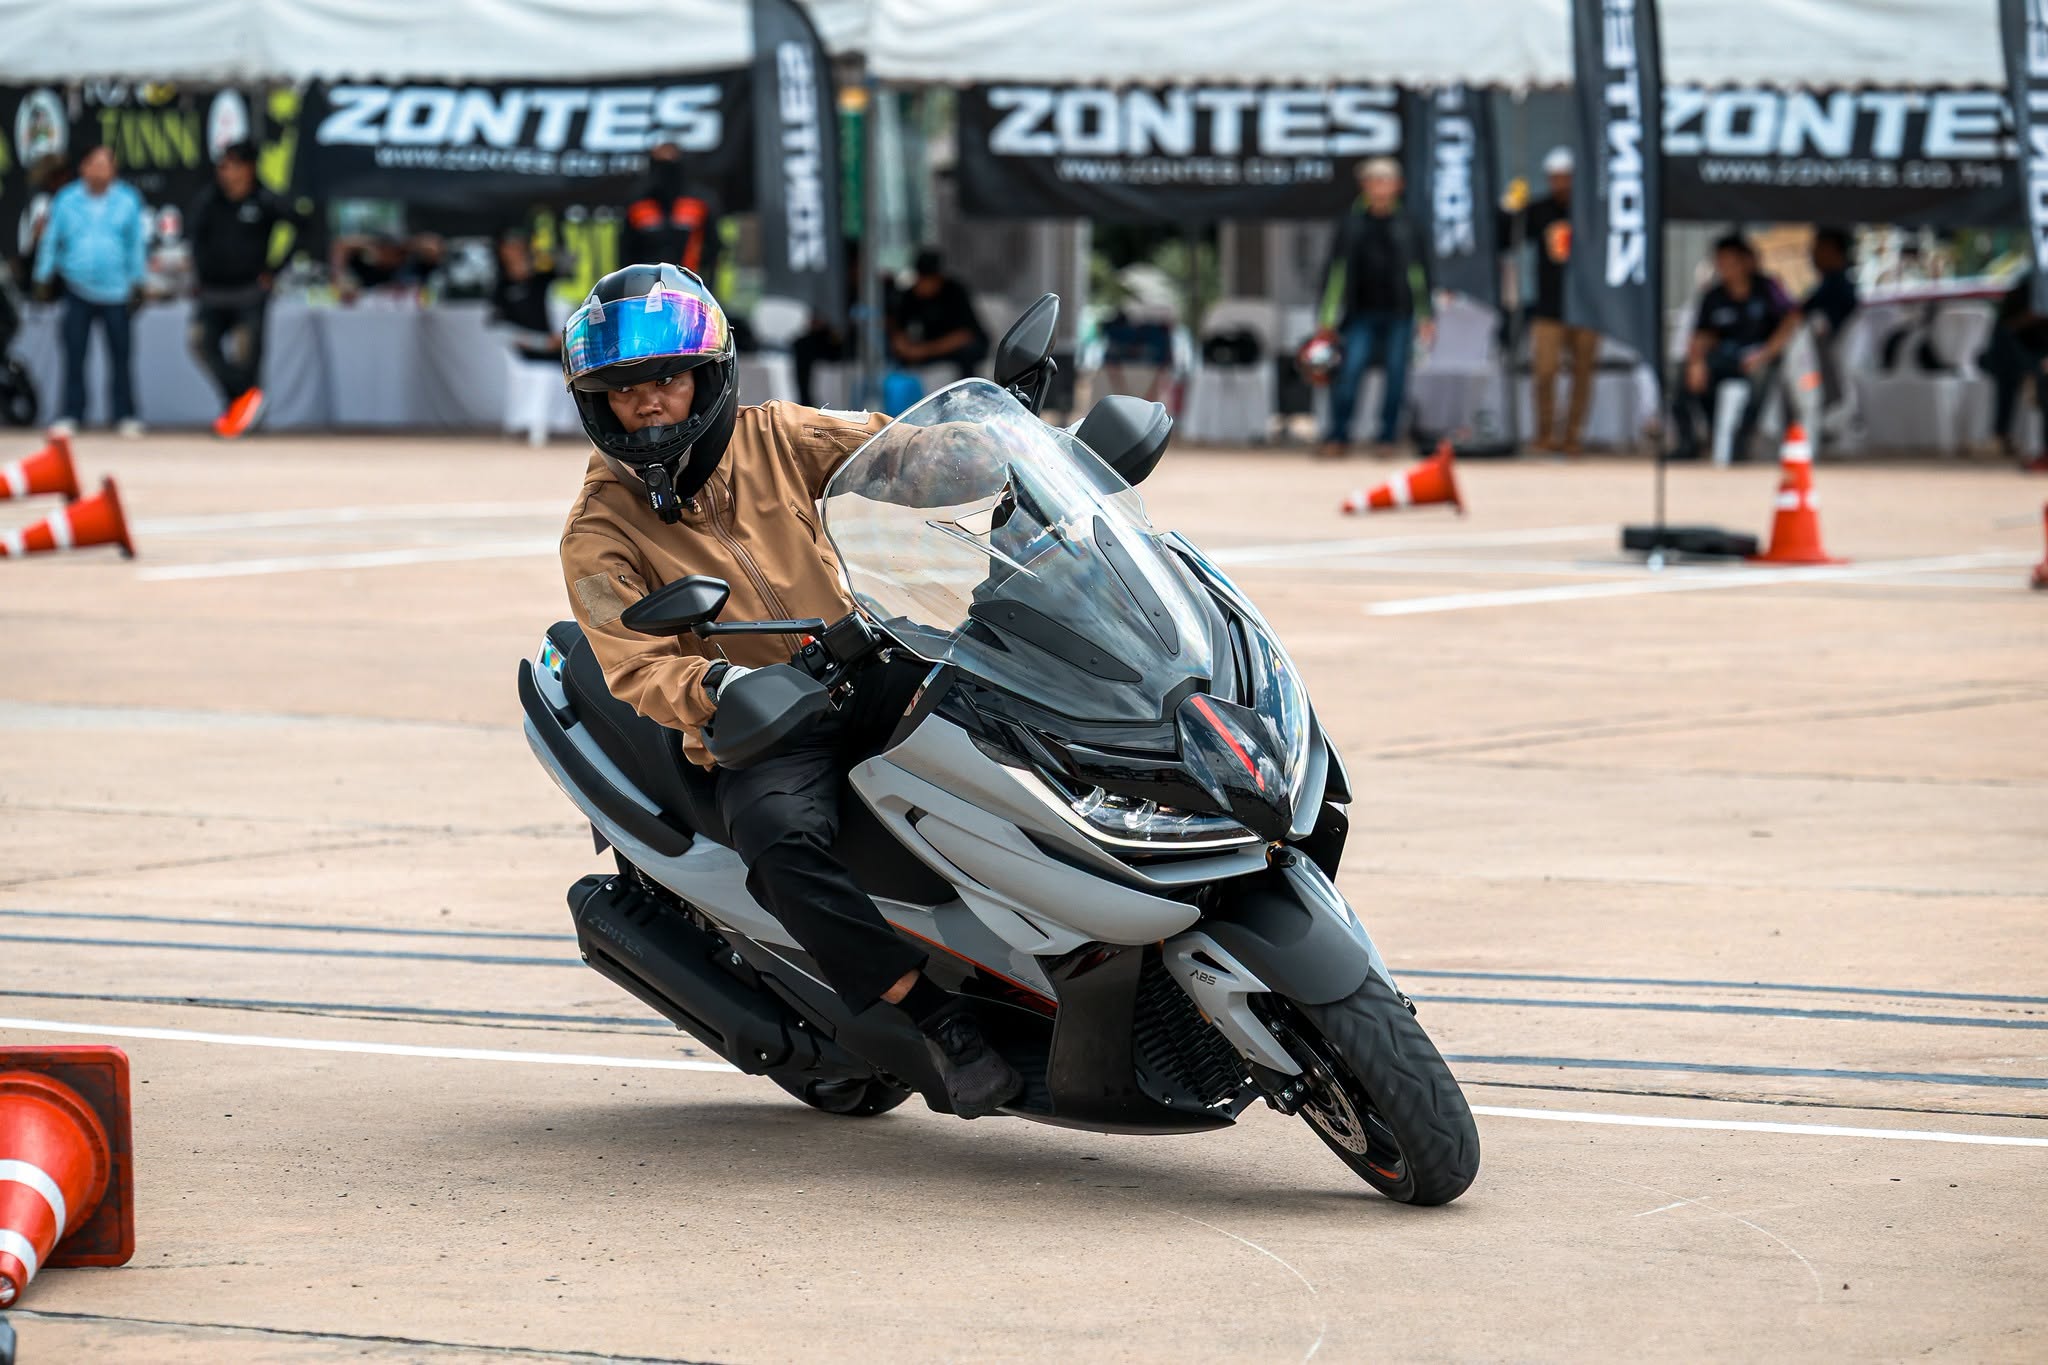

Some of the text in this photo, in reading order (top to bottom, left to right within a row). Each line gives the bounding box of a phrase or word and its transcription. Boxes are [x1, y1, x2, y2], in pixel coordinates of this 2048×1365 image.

[316, 86, 723, 152] ZONTES
[987, 88, 1399, 155] ZONTES
[1663, 89, 2022, 157] ZONTE
[1189, 969, 1217, 986] ABS
